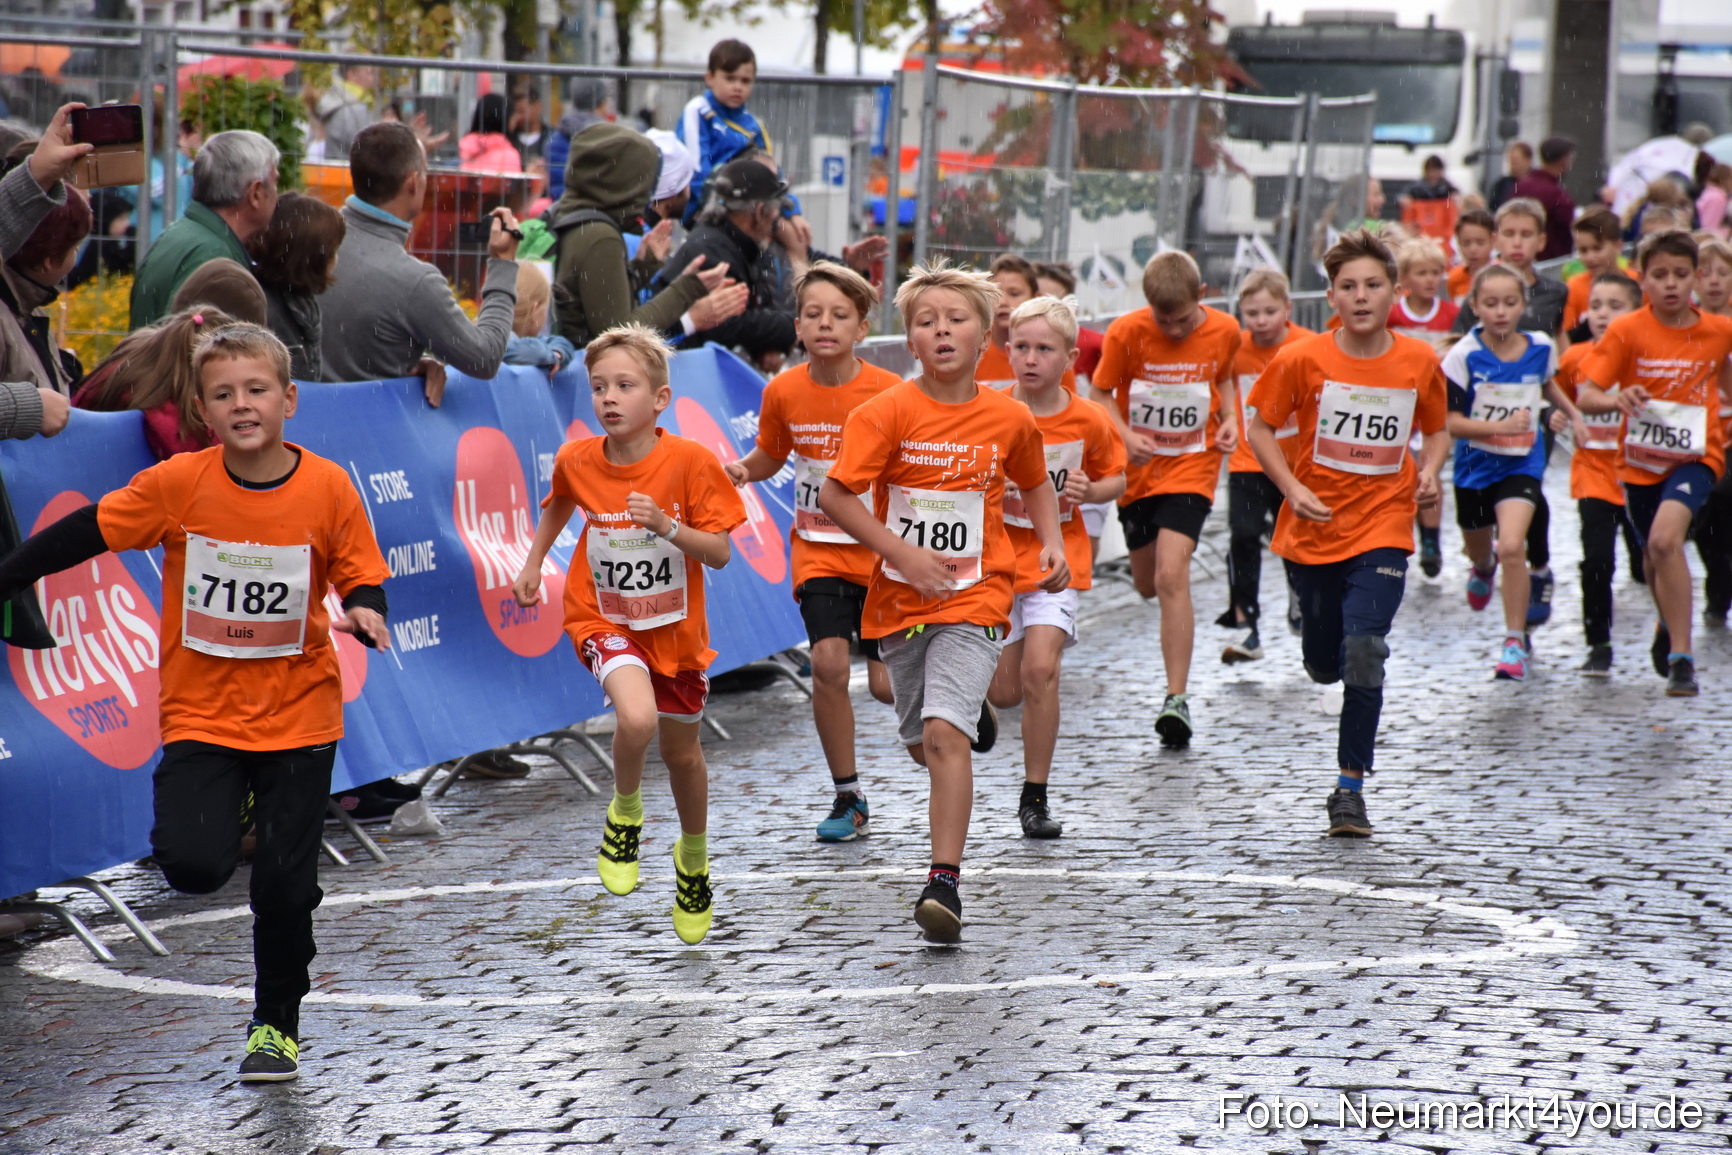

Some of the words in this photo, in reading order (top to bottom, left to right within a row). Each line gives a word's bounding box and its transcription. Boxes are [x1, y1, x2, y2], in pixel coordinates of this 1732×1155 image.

[1141, 404, 1198, 428] 7166
[1334, 410, 1399, 442] 7156
[900, 440, 970, 453] Neumarkter
[1638, 421, 1692, 449] 7058
[900, 452, 955, 468] Stadtlauf
[1350, 447, 1374, 459] Leon
[369, 470, 414, 504] STORE
[802, 482, 820, 508] 71
[919, 499, 956, 509] BOCK
[899, 517, 968, 552] 7180
[229, 553, 273, 567] BOCK
[388, 540, 436, 578] ONLINE
[600, 556, 673, 591] 7234
[201, 573, 289, 615] 7182
[226, 625, 255, 639] Luis
[394, 615, 441, 653] MOBILE
[67, 695, 130, 739] SPORTS
